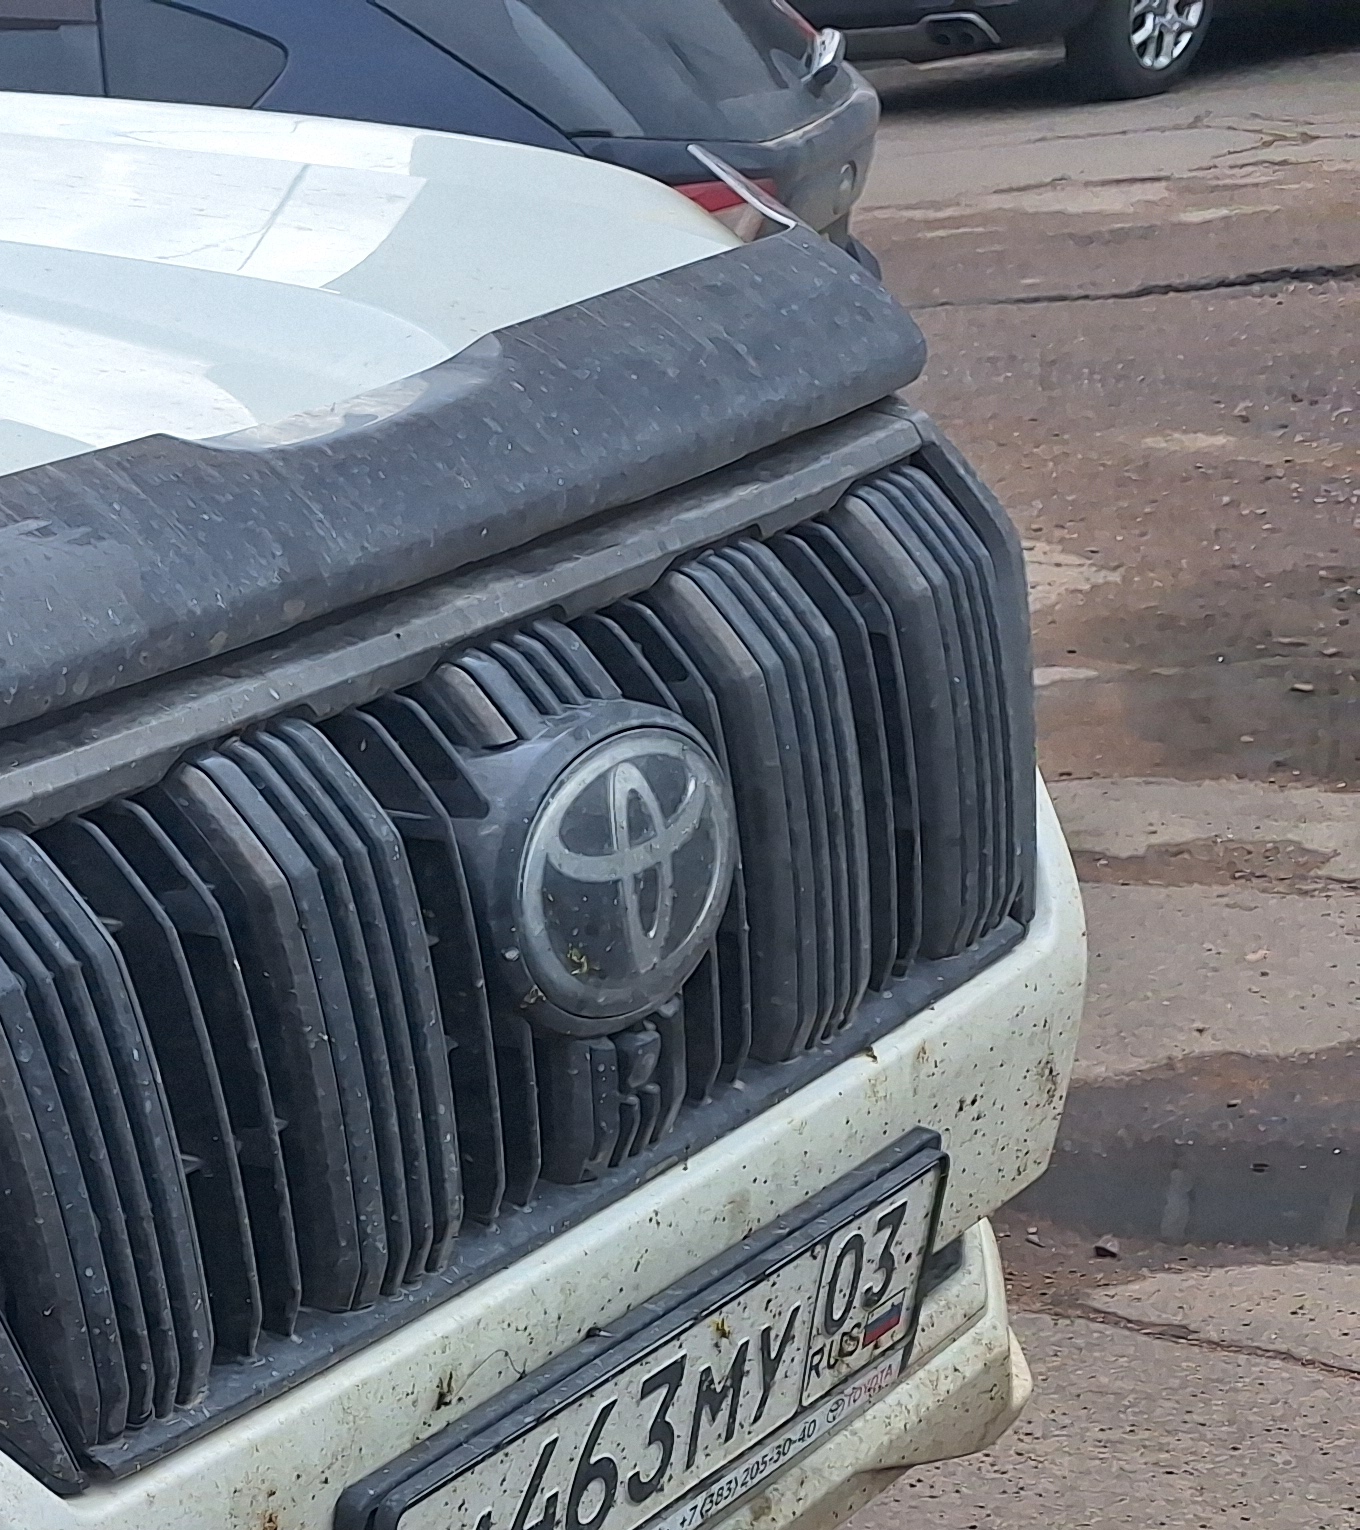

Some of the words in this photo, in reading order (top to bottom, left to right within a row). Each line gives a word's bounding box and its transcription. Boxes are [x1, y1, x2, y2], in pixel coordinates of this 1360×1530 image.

[824, 1198, 908, 1337] 03
[806, 1322, 862, 1390] RUS
[843, 1363, 894, 1407] TOYOTA
[680, 1505, 699, 1529] +7
[699, 1475, 739, 1520] (383)
[739, 1418, 817, 1489] 205-30-40
